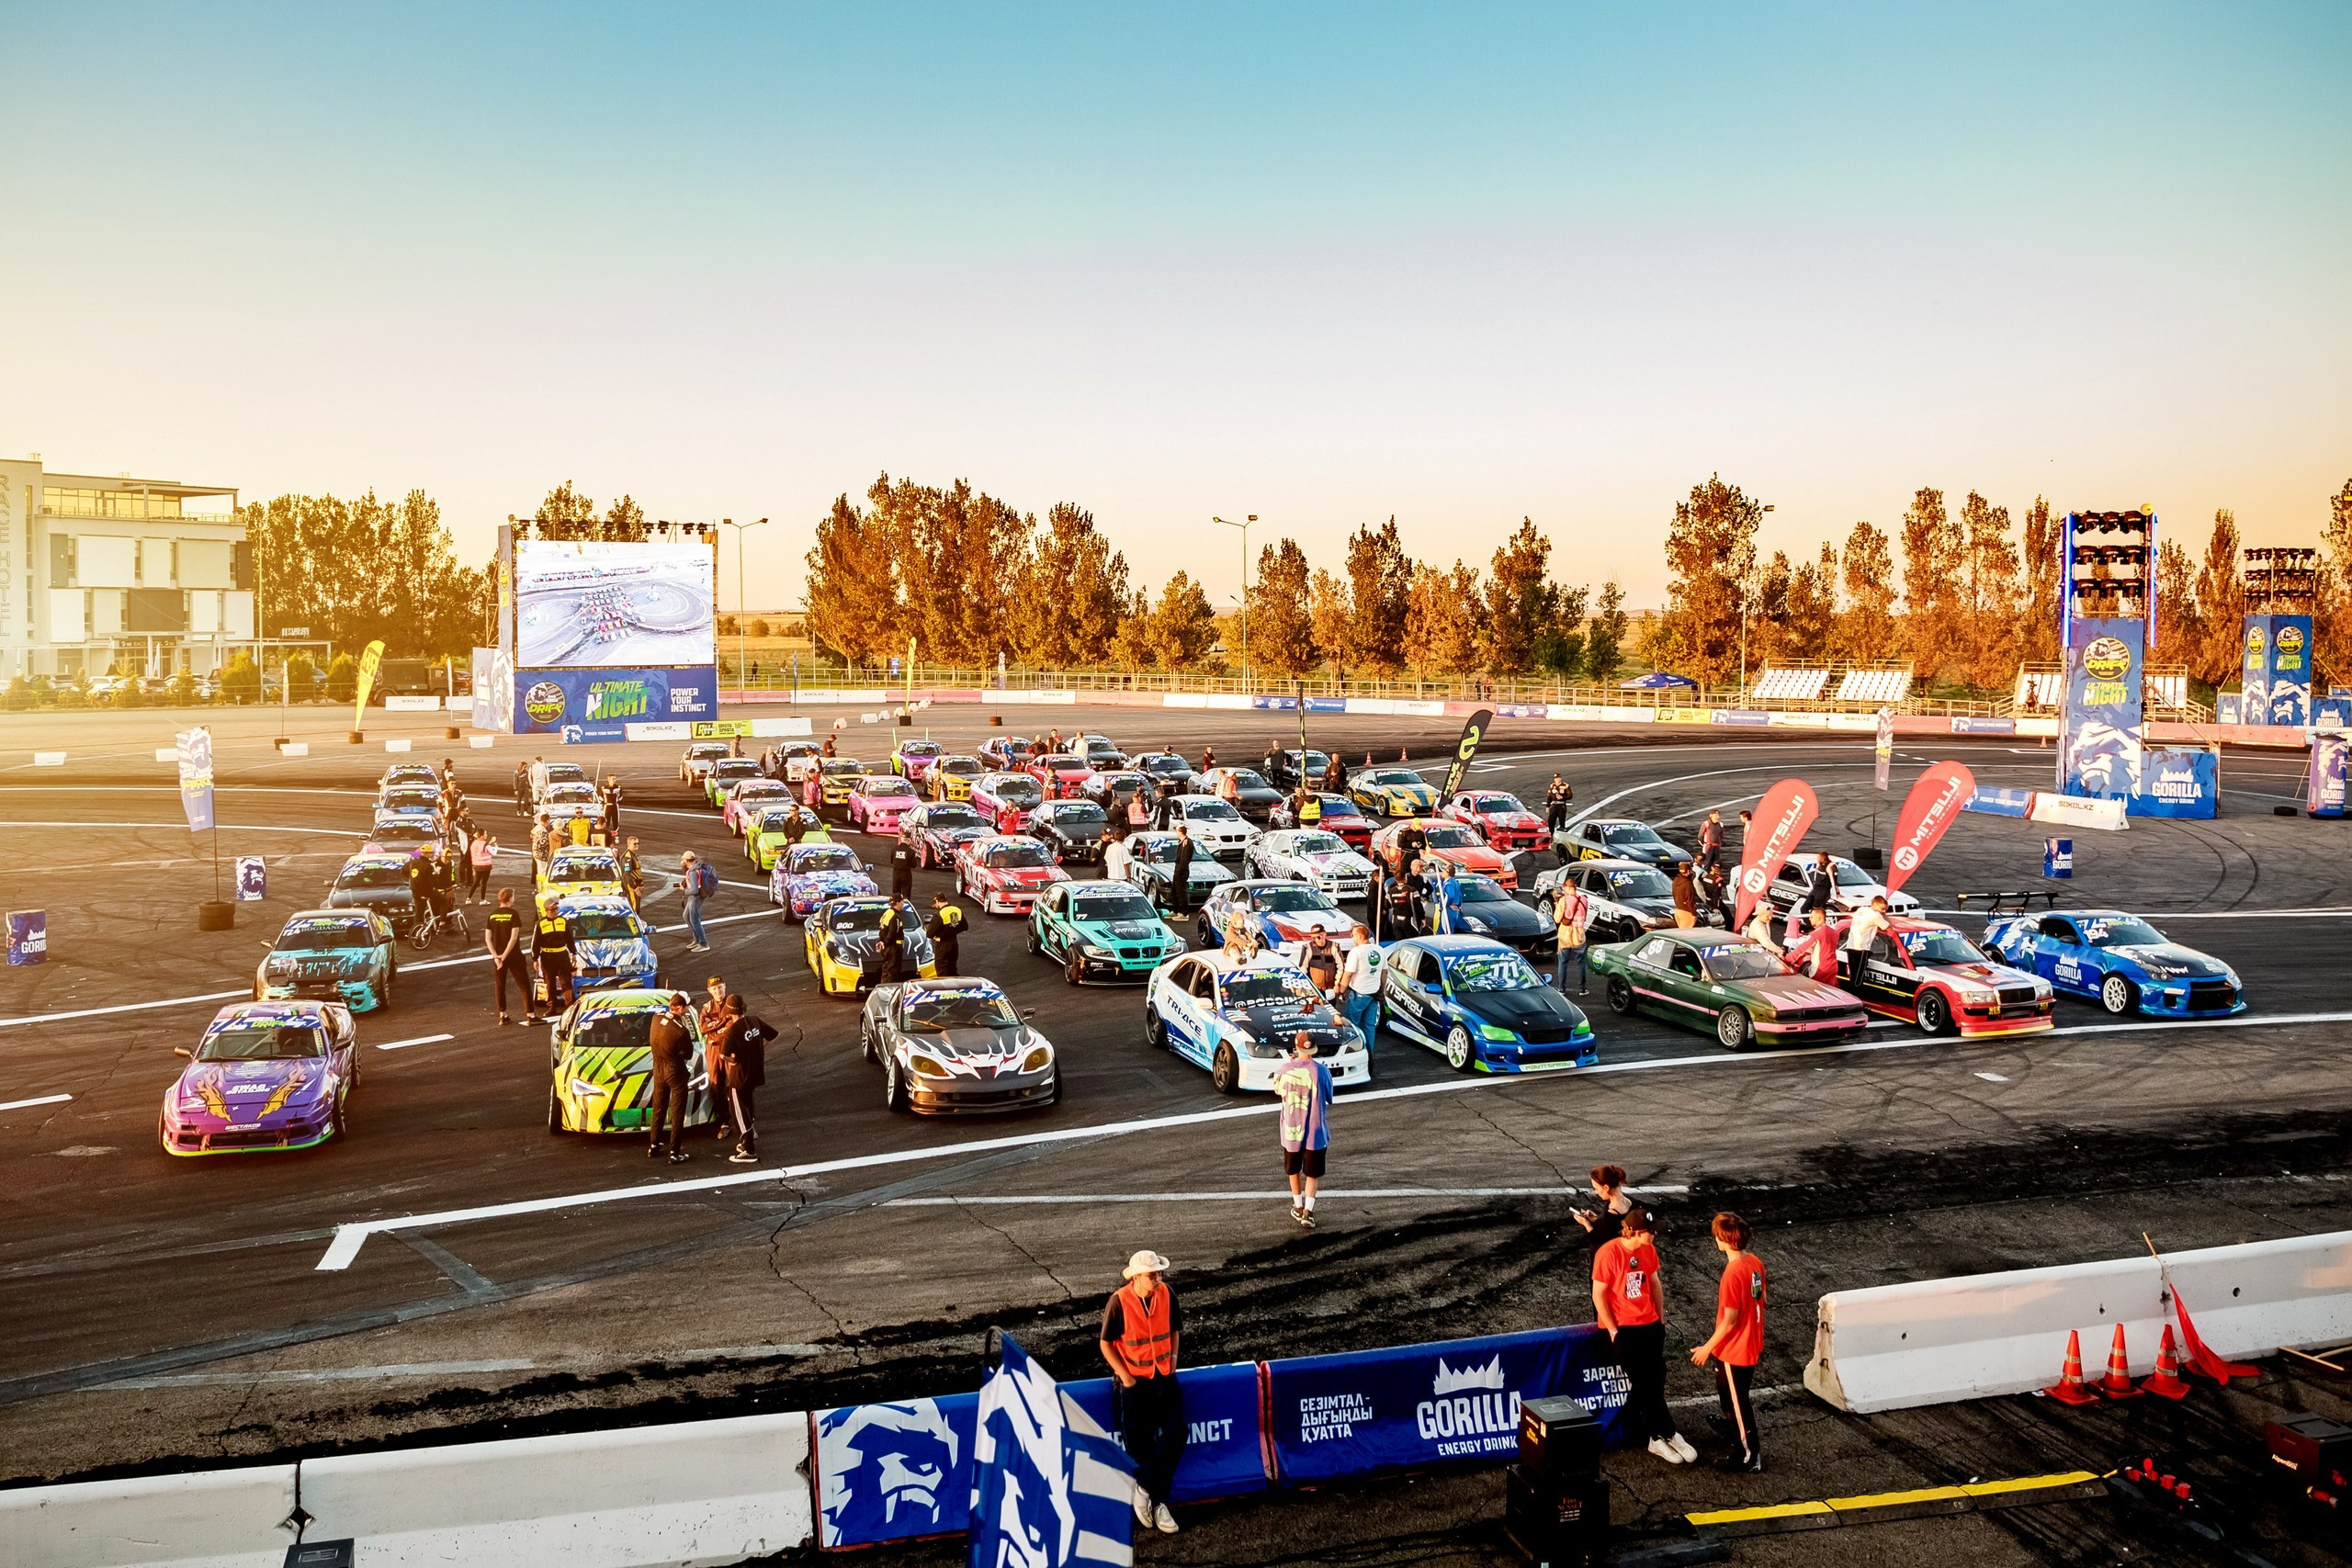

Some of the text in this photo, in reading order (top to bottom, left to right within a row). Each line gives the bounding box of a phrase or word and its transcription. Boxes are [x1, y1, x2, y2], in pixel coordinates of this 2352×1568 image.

[589, 680, 644, 694] ULTIMATE
[671, 688, 698, 696] POWER
[2086, 682, 2125, 690] ULTIMATE
[585, 687, 650, 721] NIGHT
[671, 696, 692, 705] YOUR
[2083, 687, 2128, 705] NIGHT
[671, 704, 707, 713] INSTINCT
[2315, 716, 2344, 728] GORILLA
[2152, 782, 2202, 798] GORILLA
[1910, 776, 1962, 847] MITSUJI
[2059, 800, 2094, 811] SOKOL.KZ
[1758, 795, 1804, 869] MITSUJI
[1770, 887, 1799, 901] GENESIS
[1647, 939, 1665, 955] 88
[1907, 942, 1927, 953] 555
[1401, 949, 1417, 966] 771
[1490, 961, 1519, 979] 771
[2055, 964, 2082, 981] GORILLA
[1282, 978, 1312, 989] 888
[1167, 995, 1203, 1036] TRI-ACE
[577, 1021, 593, 1031] 38
[1583, 1365, 1628, 1382] ЗАРЯД
[1574, 1393, 1628, 1411] НСТИНК
[1417, 1391, 1522, 1439] GORILLA
[1301, 1423, 1352, 1443] ҚУАТТА
[1437, 1438, 1482, 1456] ENERGY
[1483, 1437, 1519, 1452] DRINK
[1953, 1501, 1964, 1509] FS
[1815, 1517, 1826, 1526] FS
